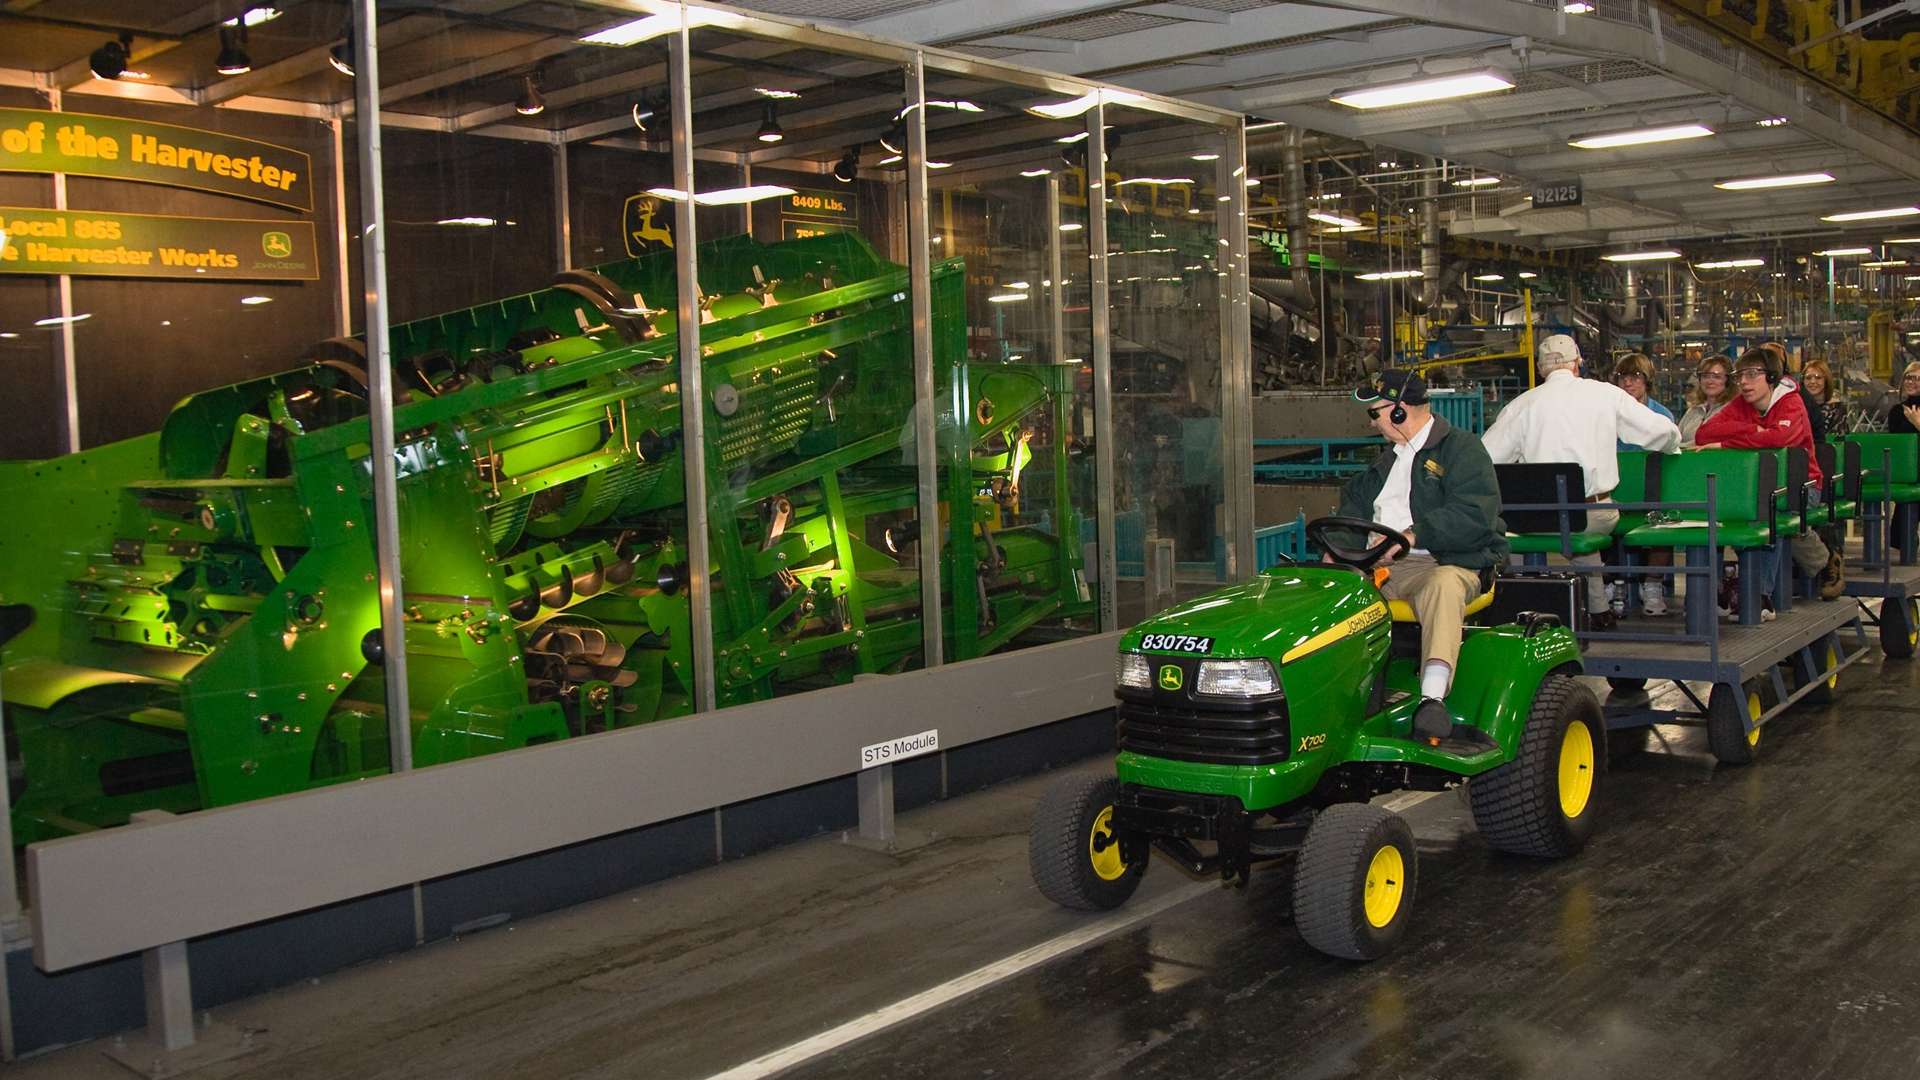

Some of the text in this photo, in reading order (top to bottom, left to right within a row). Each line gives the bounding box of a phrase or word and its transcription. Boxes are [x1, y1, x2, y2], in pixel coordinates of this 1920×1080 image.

[1, 121, 297, 192] of the Harvester
[792, 195, 847, 212] 8409 Lbs.
[1536, 185, 1577, 203] 92125
[74, 219, 122, 240] 865
[26, 242, 152, 265] Harvester
[159, 247, 239, 269] Works
[1348, 606, 1383, 634] JOHN DEERE
[1141, 634, 1210, 653] 830754
[864, 734, 936, 763] STS Module
[1297, 733, 1327, 751] X700
